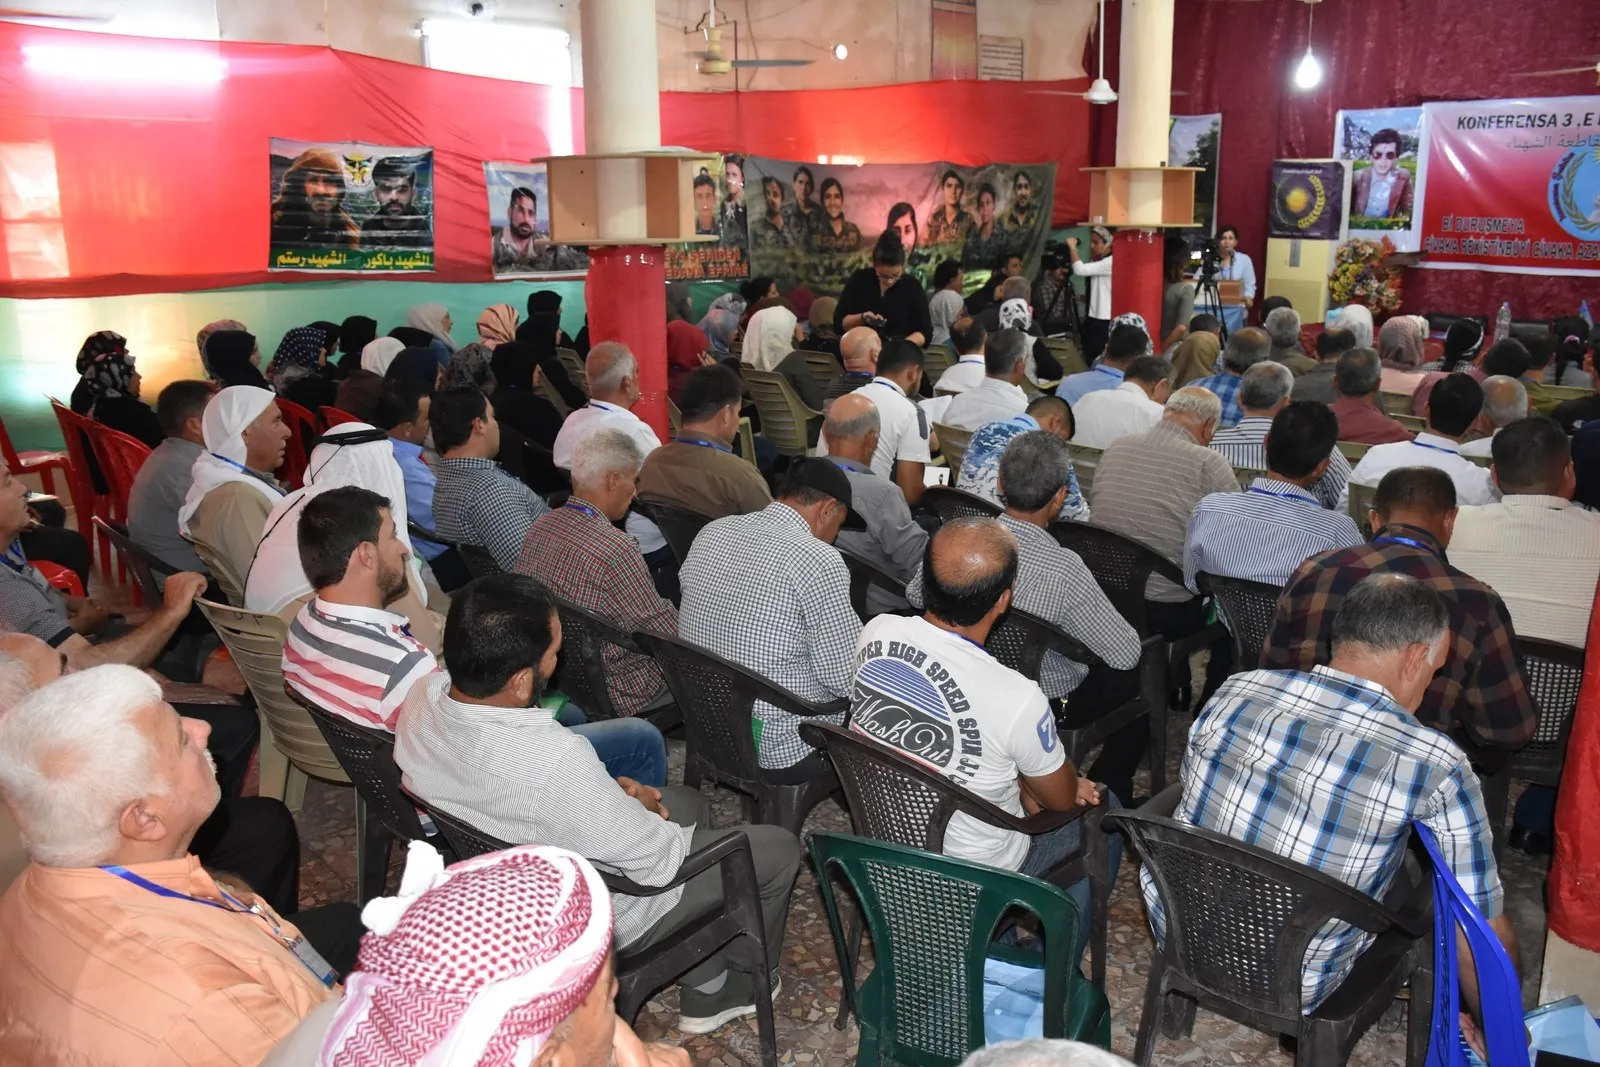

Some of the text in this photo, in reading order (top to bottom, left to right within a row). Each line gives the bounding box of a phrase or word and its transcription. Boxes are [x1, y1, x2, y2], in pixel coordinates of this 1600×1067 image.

[1457, 113, 1557, 129] KONFERENSA
[1562, 112, 1573, 127] 3
[1556, 133, 1600, 147] قاطعة
[277, 250, 346, 267] الشهيد رستم
[365, 253, 429, 270] الشهيد باكور
[855, 640, 883, 672] UPER
[887, 640, 928, 669] HIGH
[926, 662, 971, 713] SPEED
[957, 718, 982, 757] SPIN
